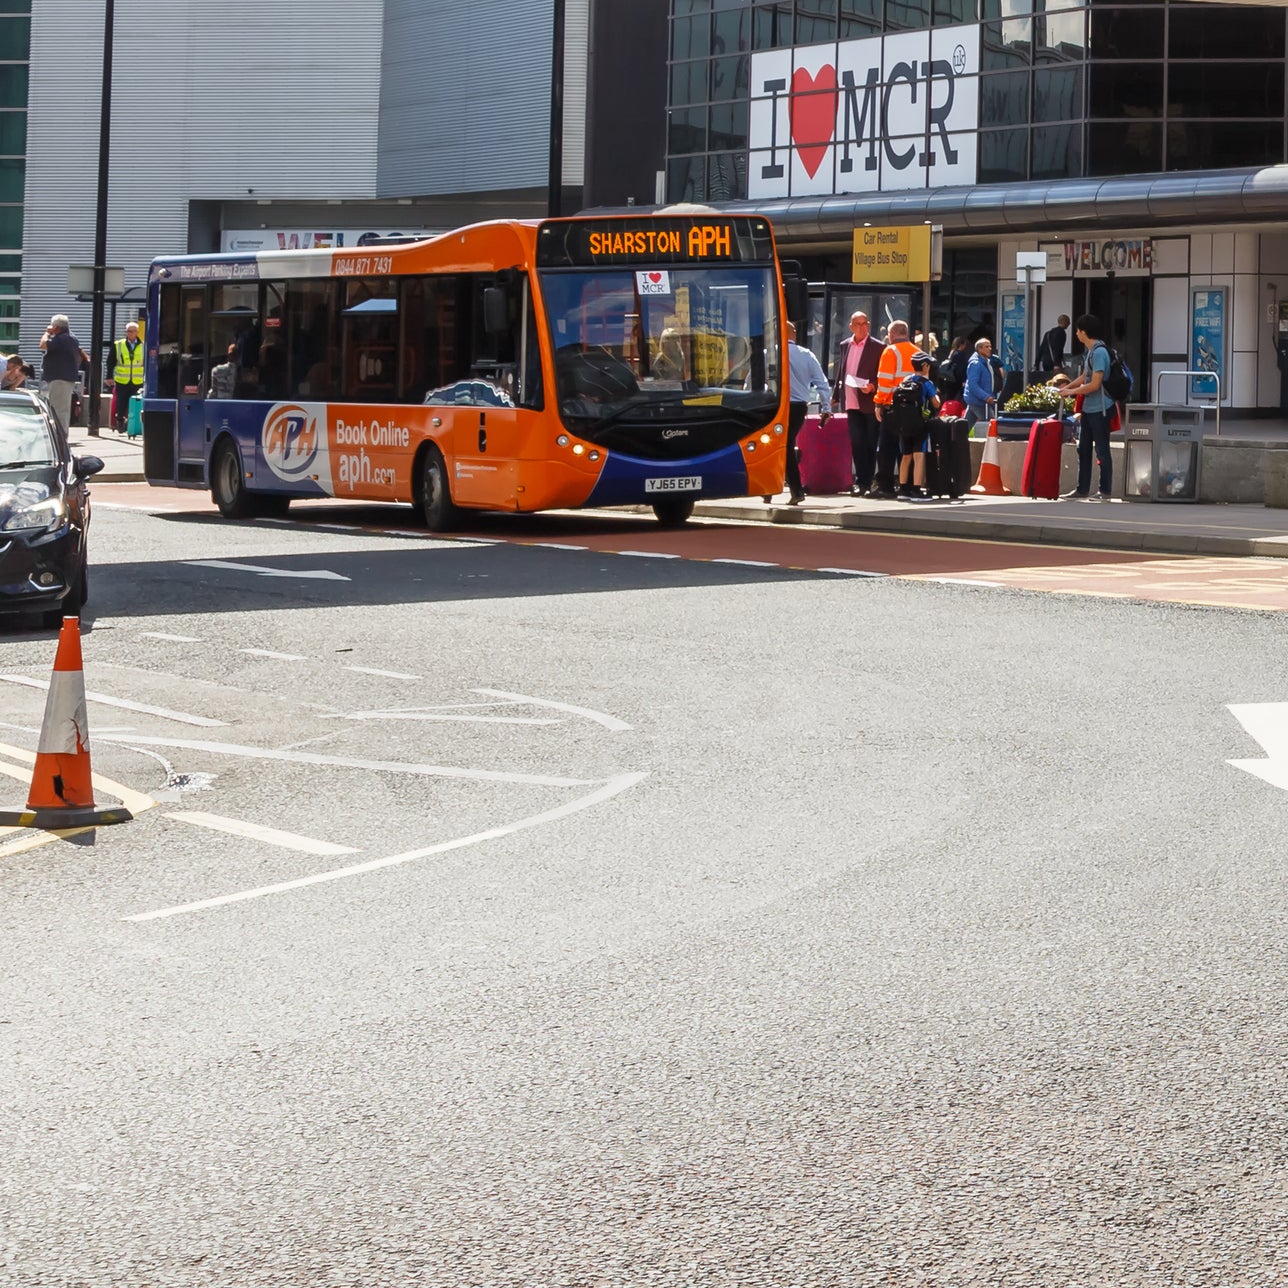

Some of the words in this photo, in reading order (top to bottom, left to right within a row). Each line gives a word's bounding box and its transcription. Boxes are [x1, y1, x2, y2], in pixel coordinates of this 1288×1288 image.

[840, 59, 959, 173] MCR
[589, 231, 680, 255] SHARSTON
[688, 226, 731, 256] APH
[864, 231, 875, 245] Car
[877, 231, 898, 245] Rental
[855, 252, 875, 268] Village
[877, 252, 890, 265] Bus
[891, 251, 908, 267] Stop
[1064, 240, 1154, 270] WELCOME
[180, 266, 191, 278] The
[192, 265, 211, 280] Airport
[211, 264, 232, 279] Parking
[335, 259, 354, 275] 0844
[356, 259, 370, 274] 871
[373, 257, 393, 273] 7431
[641, 273, 648, 284] I
[642, 284, 665, 293] MCR
[268, 416, 317, 461] APH
[336, 419, 367, 447] Book
[370, 419, 409, 448] Online
[339, 447, 396, 492] aph.com
[650, 479, 675, 490] YJ65
[678, 478, 697, 489] EPV
